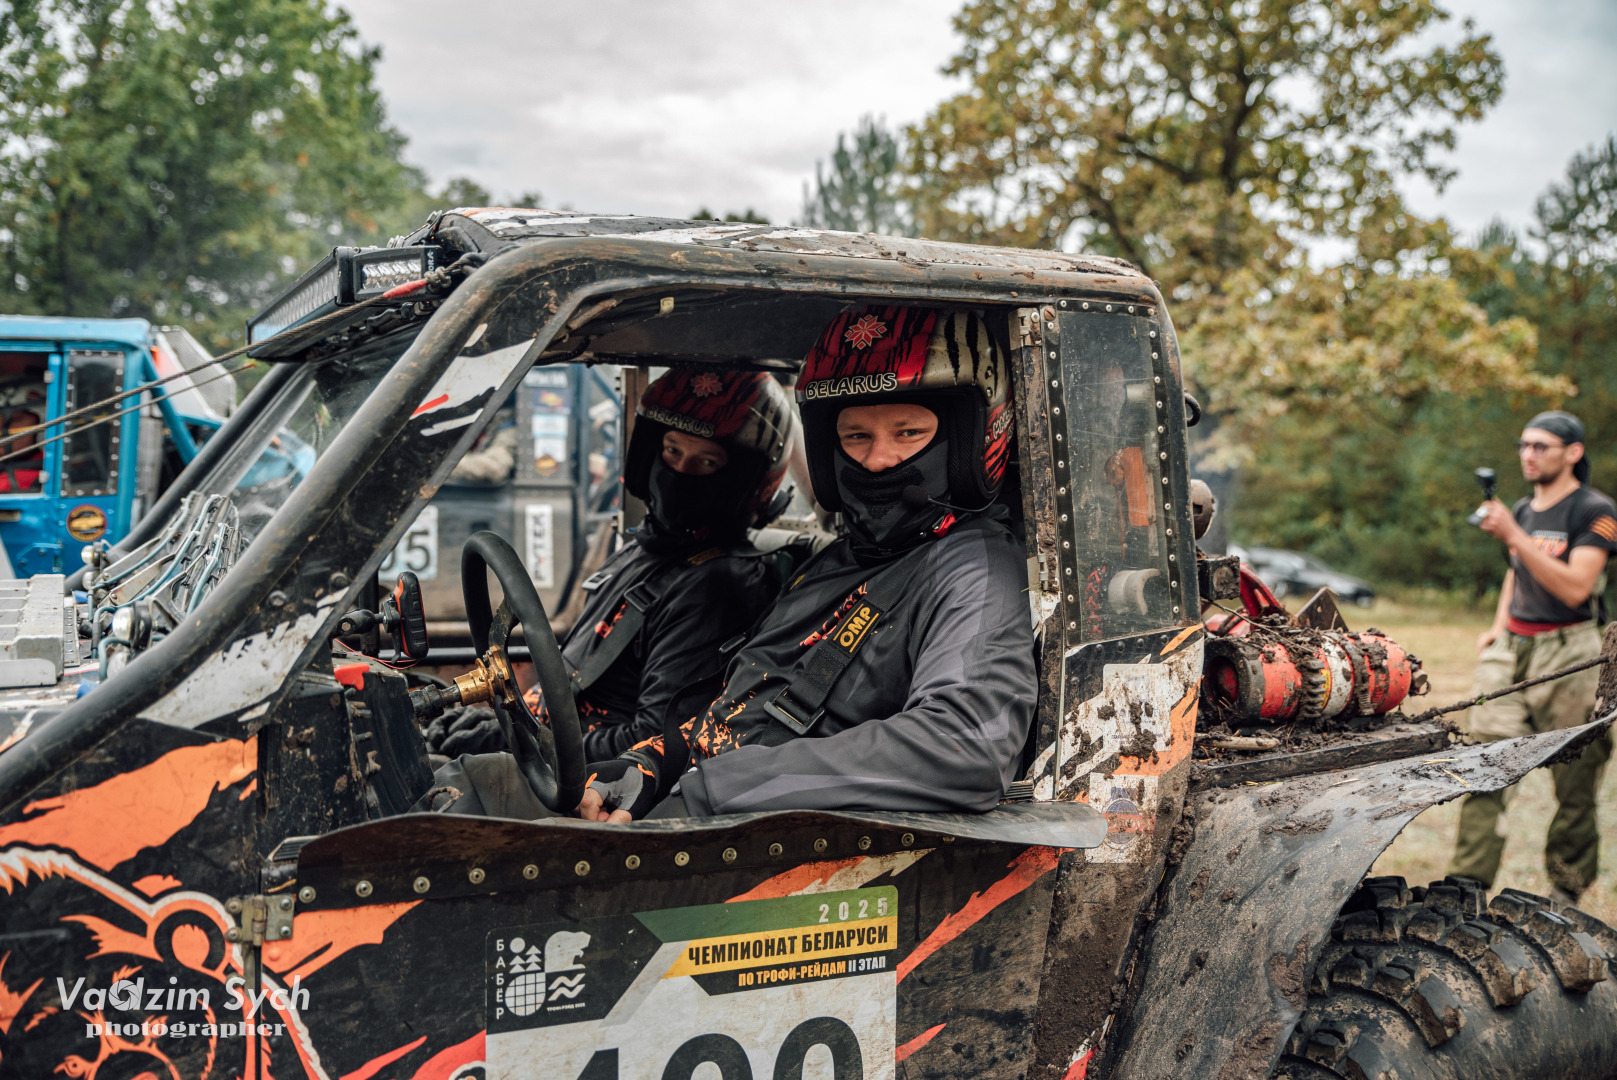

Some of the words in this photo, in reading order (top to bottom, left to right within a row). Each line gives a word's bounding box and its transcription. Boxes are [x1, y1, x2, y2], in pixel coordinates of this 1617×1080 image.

[805, 372, 898, 400] BELARUS
[647, 407, 715, 438] BELARUS
[840, 607, 871, 647] OMP
[818, 897, 889, 923] 2025
[688, 936, 798, 967] ЧЕМПИОНАТ
[801, 925, 889, 953] БЕЛАРУСИ
[738, 971, 755, 987] ПО
[756, 961, 847, 985] ТРОФИ-РЕЙДАМ
[848, 959, 857, 973] II
[858, 955, 887, 971] ЭТАП
